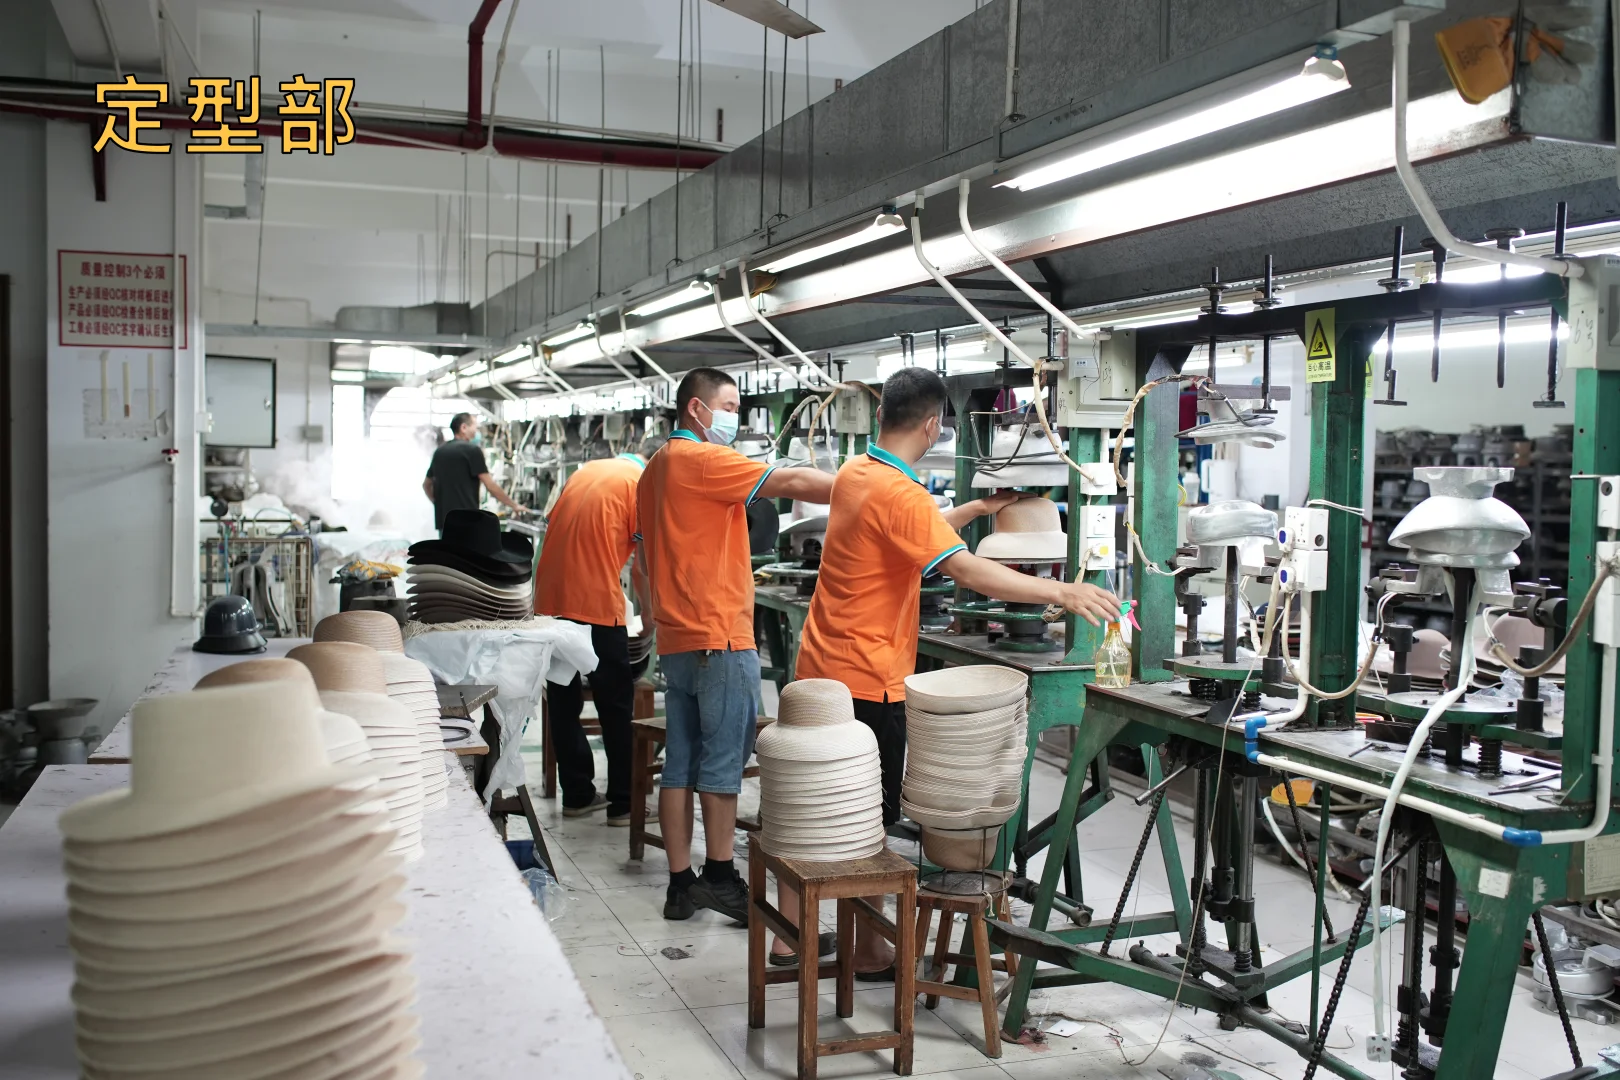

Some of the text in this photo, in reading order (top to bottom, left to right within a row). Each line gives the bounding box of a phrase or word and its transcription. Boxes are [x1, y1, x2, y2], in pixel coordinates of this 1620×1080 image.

[80, 261, 166, 280] 质量控制3个必须
